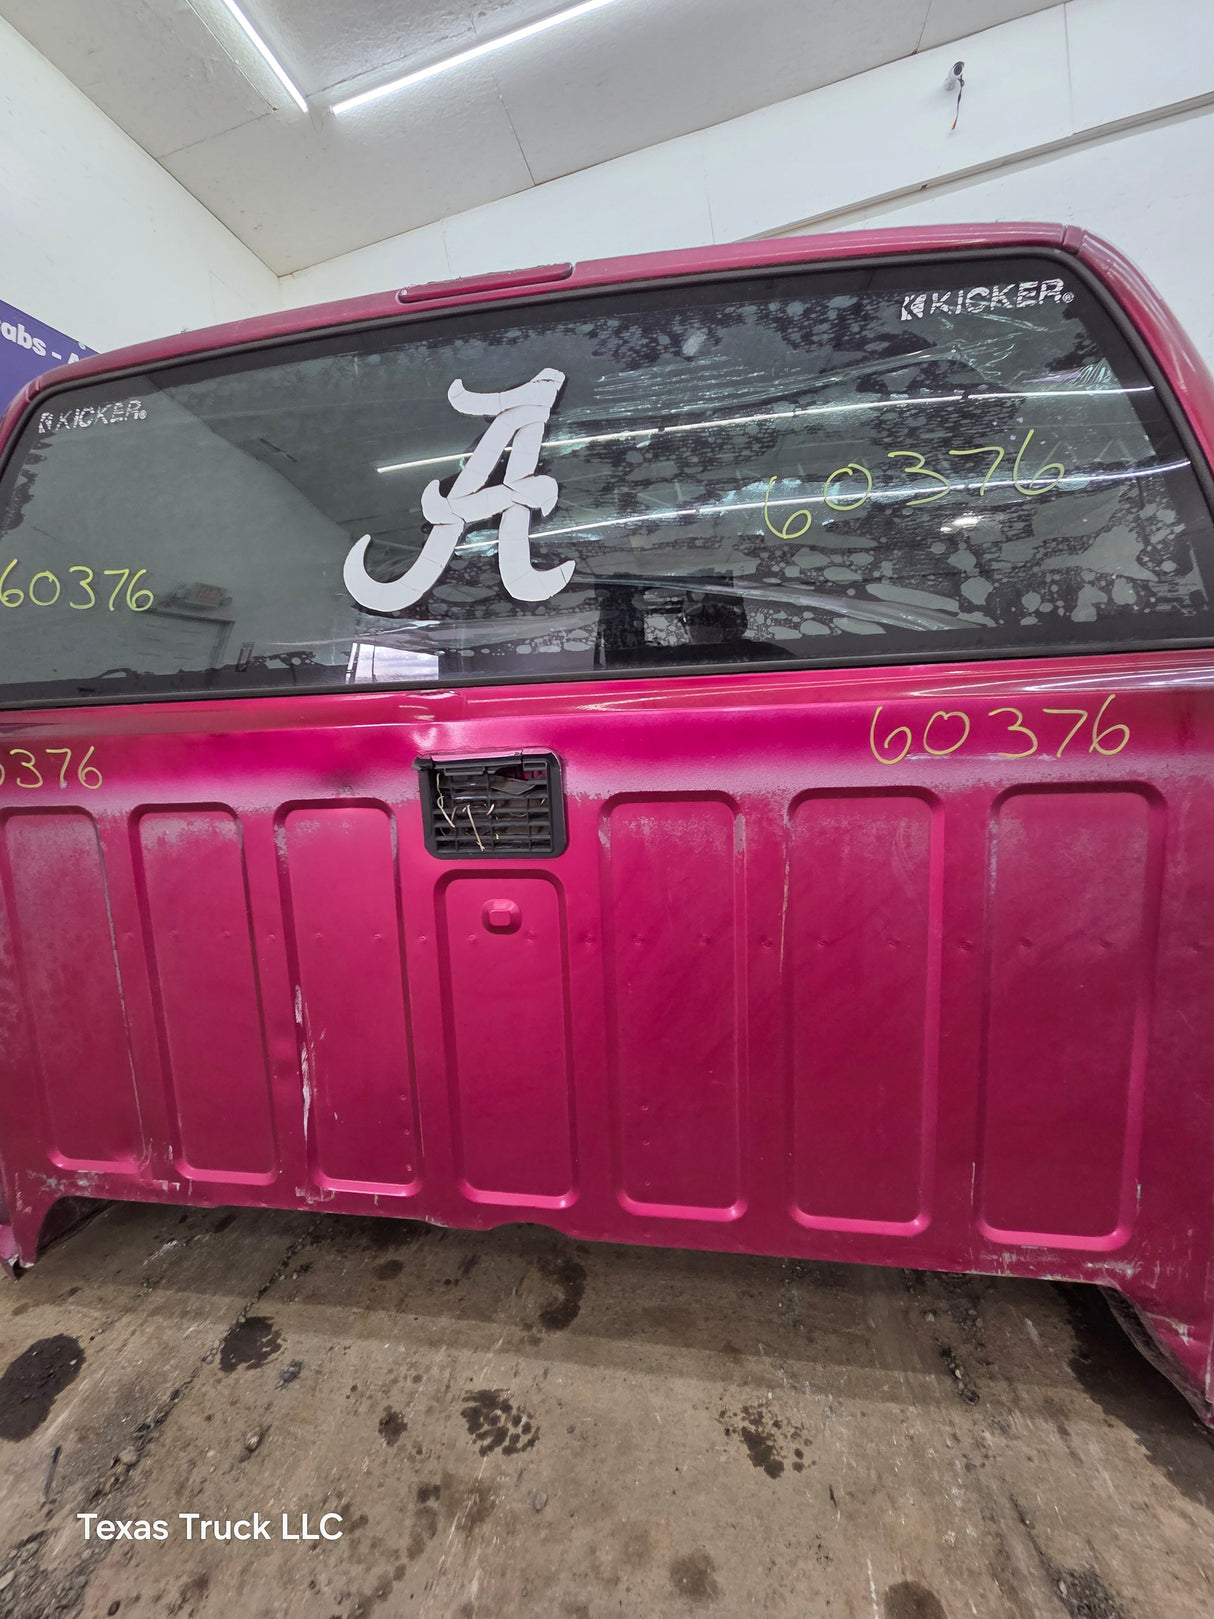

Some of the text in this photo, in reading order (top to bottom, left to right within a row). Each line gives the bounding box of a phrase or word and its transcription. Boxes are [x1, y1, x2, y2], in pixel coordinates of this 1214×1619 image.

[0, 319, 47, 357] abs
[764, 428, 1066, 540] 60376
[0, 558, 154, 612] 60376
[869, 693, 1131, 766] 60376
[0, 745, 103, 790] 376
